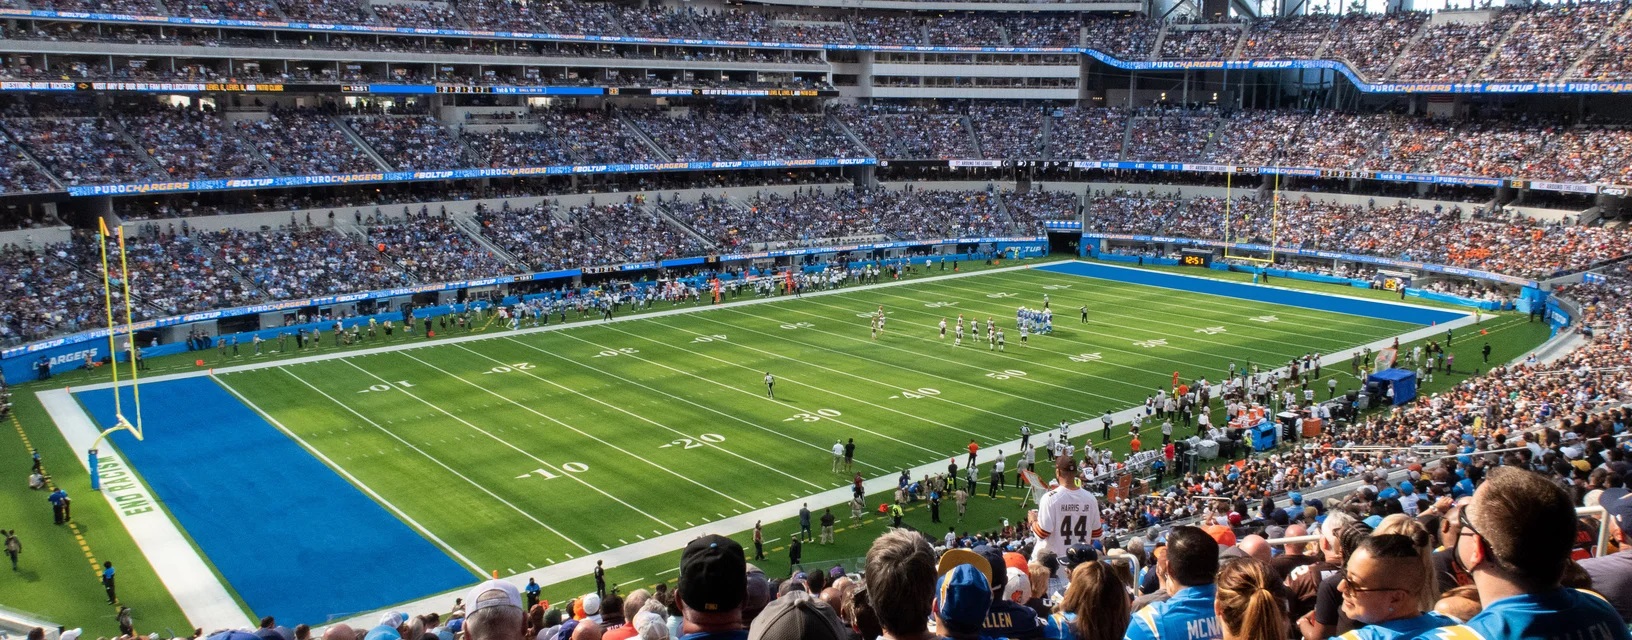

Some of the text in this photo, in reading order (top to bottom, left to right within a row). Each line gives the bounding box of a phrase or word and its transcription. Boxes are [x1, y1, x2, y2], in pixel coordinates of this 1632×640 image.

[1152, 60, 1292, 69] PUROCHARGERS #BOLTUP
[0, 82, 31, 90] QUESTIONS
[32, 82, 50, 90] ABOUT
[50, 82, 75, 90] TICKETS?
[1371, 83, 1451, 93] PUROCHARGERS
[1486, 83, 1534, 92] #BOLTUP
[94, 182, 190, 195] PUROCHARGERS
[227, 178, 274, 188] #BOLTUP
[305, 174, 384, 184] PUROCHARGERS
[414, 171, 454, 179] #BOLTUP
[480, 166, 547, 177] PUROCHARGERS
[572, 165, 607, 173] #BOLTUP
[630, 162, 689, 171] PUROCHARGERS
[711, 160, 743, 168] #BOLTUP
[837, 158, 866, 166] #BOLTUP
[1185, 256, 1204, 265] 12:51
[27, 338, 66, 351] #BOLTUP
[182, 311, 222, 322] #BOLTUP
[247, 299, 311, 313] PUROCHARGERS
[335, 293, 369, 302] #BOLTUP
[390, 284, 447, 296] PUROCHARGERS
[466, 278, 497, 287] #BOLTUP
[695, 334, 728, 342] 40
[599, 347, 640, 357] 30
[33, 348, 98, 370] CARGERS
[491, 362, 536, 373] 20
[985, 369, 1027, 380] 50
[369, 380, 417, 392] 10
[902, 387, 941, 399] 40
[793, 408, 842, 422] 30
[671, 433, 726, 449] 20
[529, 461, 590, 481] 10
[98, 455, 154, 517] END RACISM
[1061, 504, 1090, 512] HARRIS JR
[1060, 515, 1088, 546] 44
